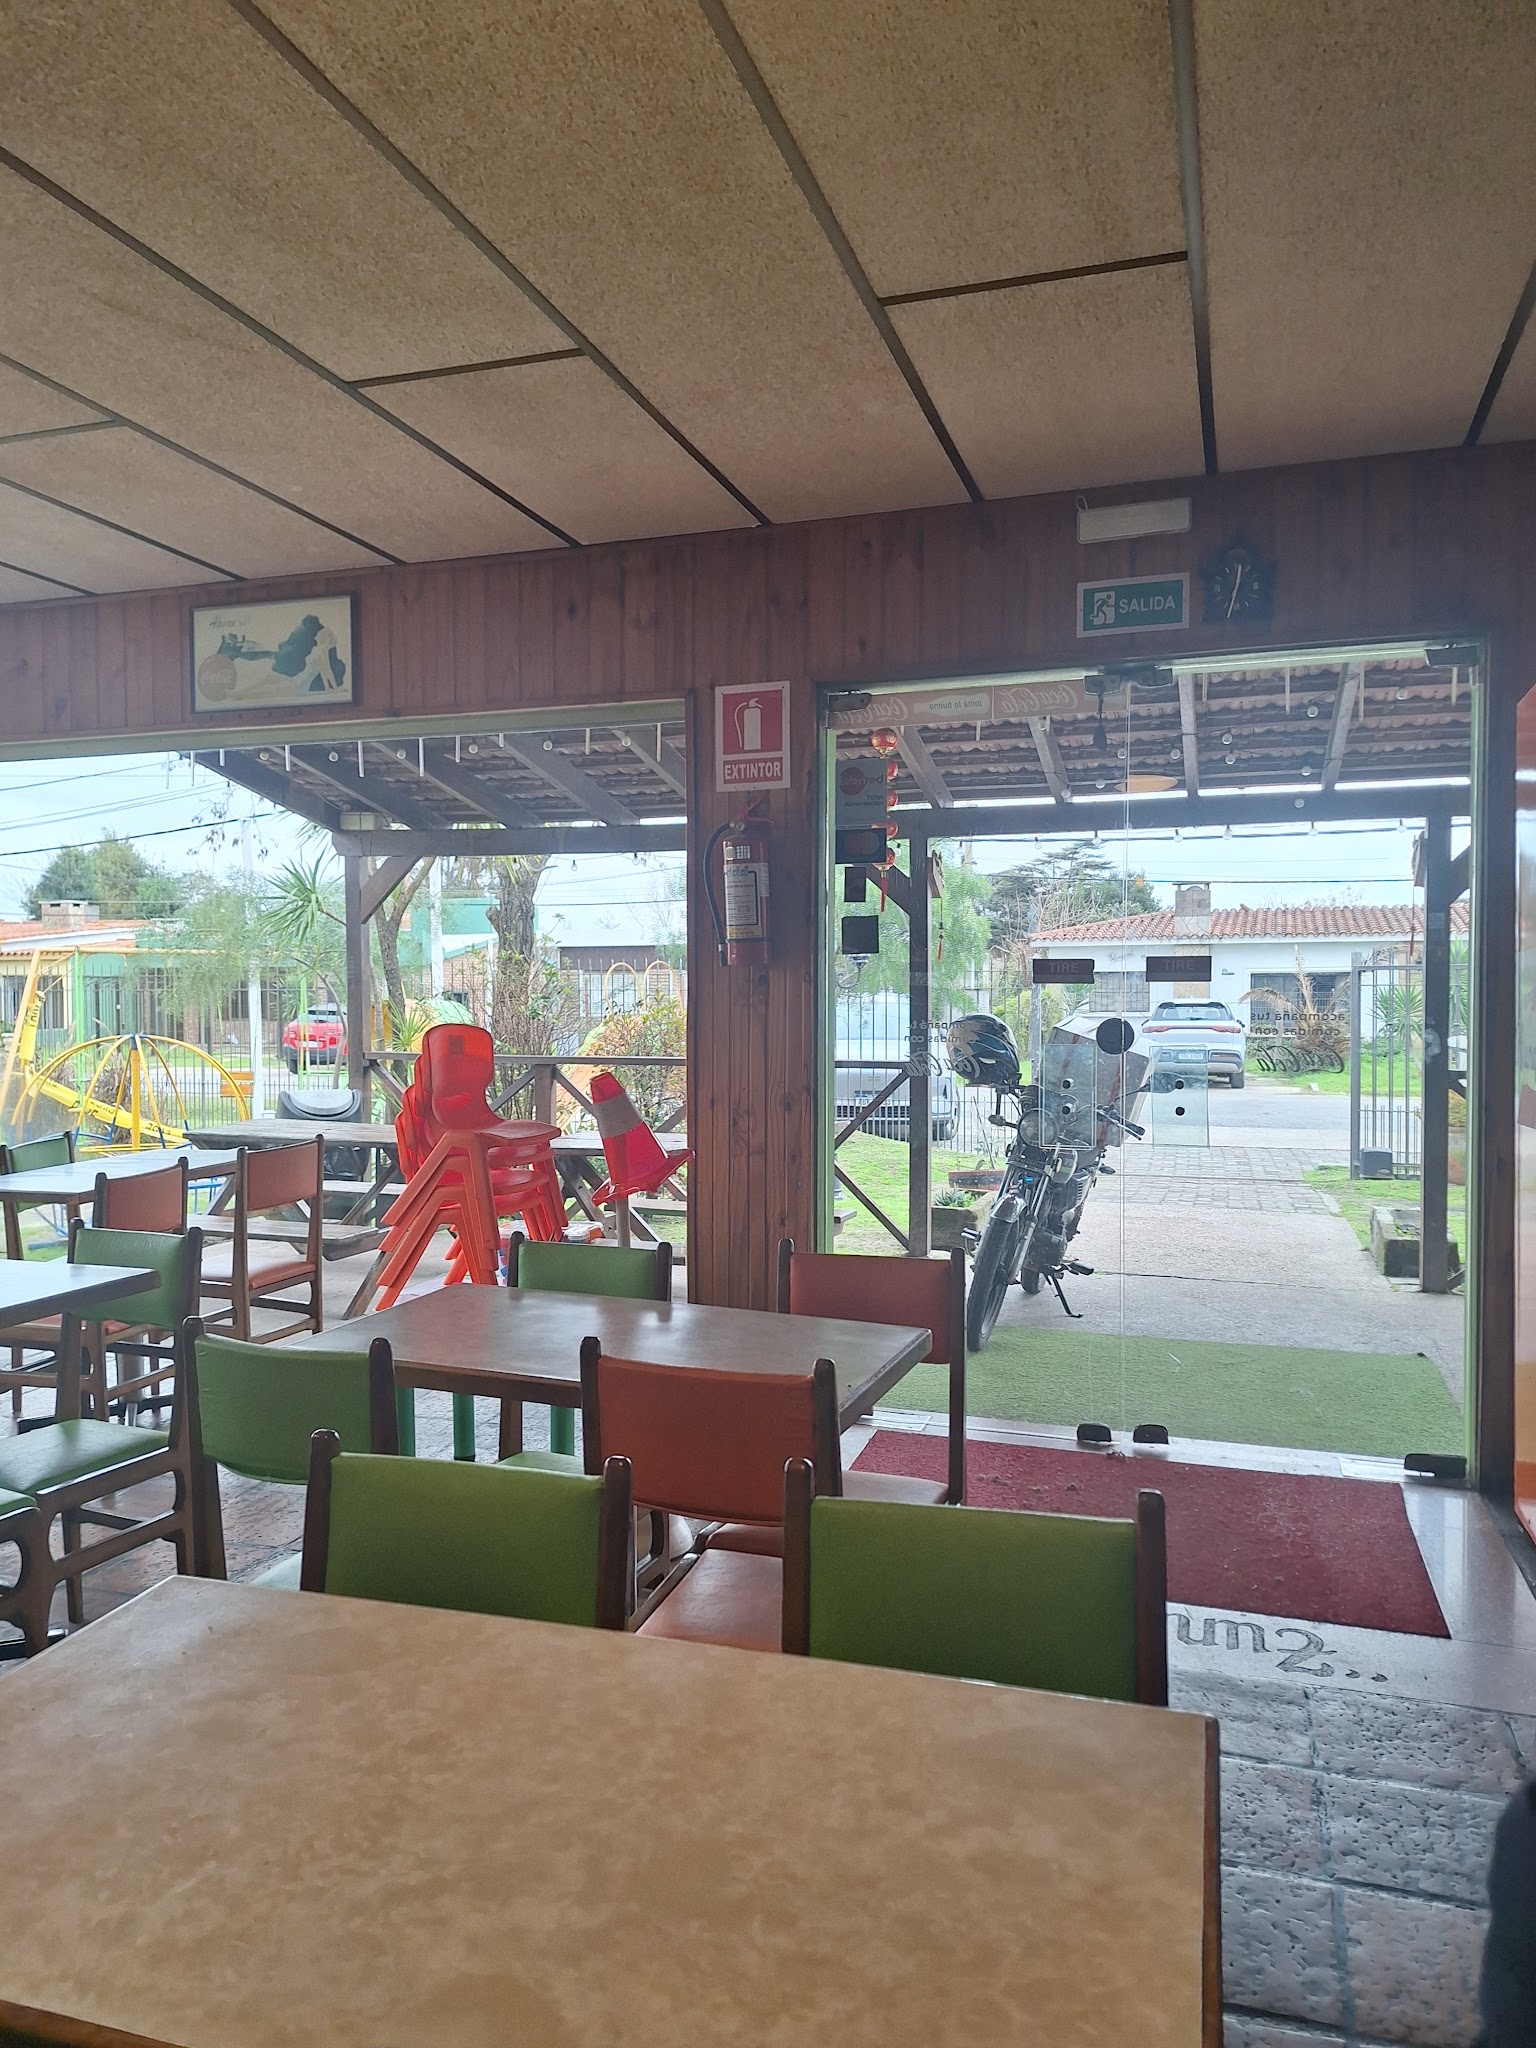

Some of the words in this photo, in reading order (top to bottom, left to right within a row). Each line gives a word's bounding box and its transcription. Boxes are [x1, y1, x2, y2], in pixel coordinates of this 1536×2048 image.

[1119, 595, 1176, 614] SALIDA
[724, 761, 781, 781] EXTINTOR
[1048, 962, 1079, 973] TIRE
[1162, 959, 1195, 971] TIRE
